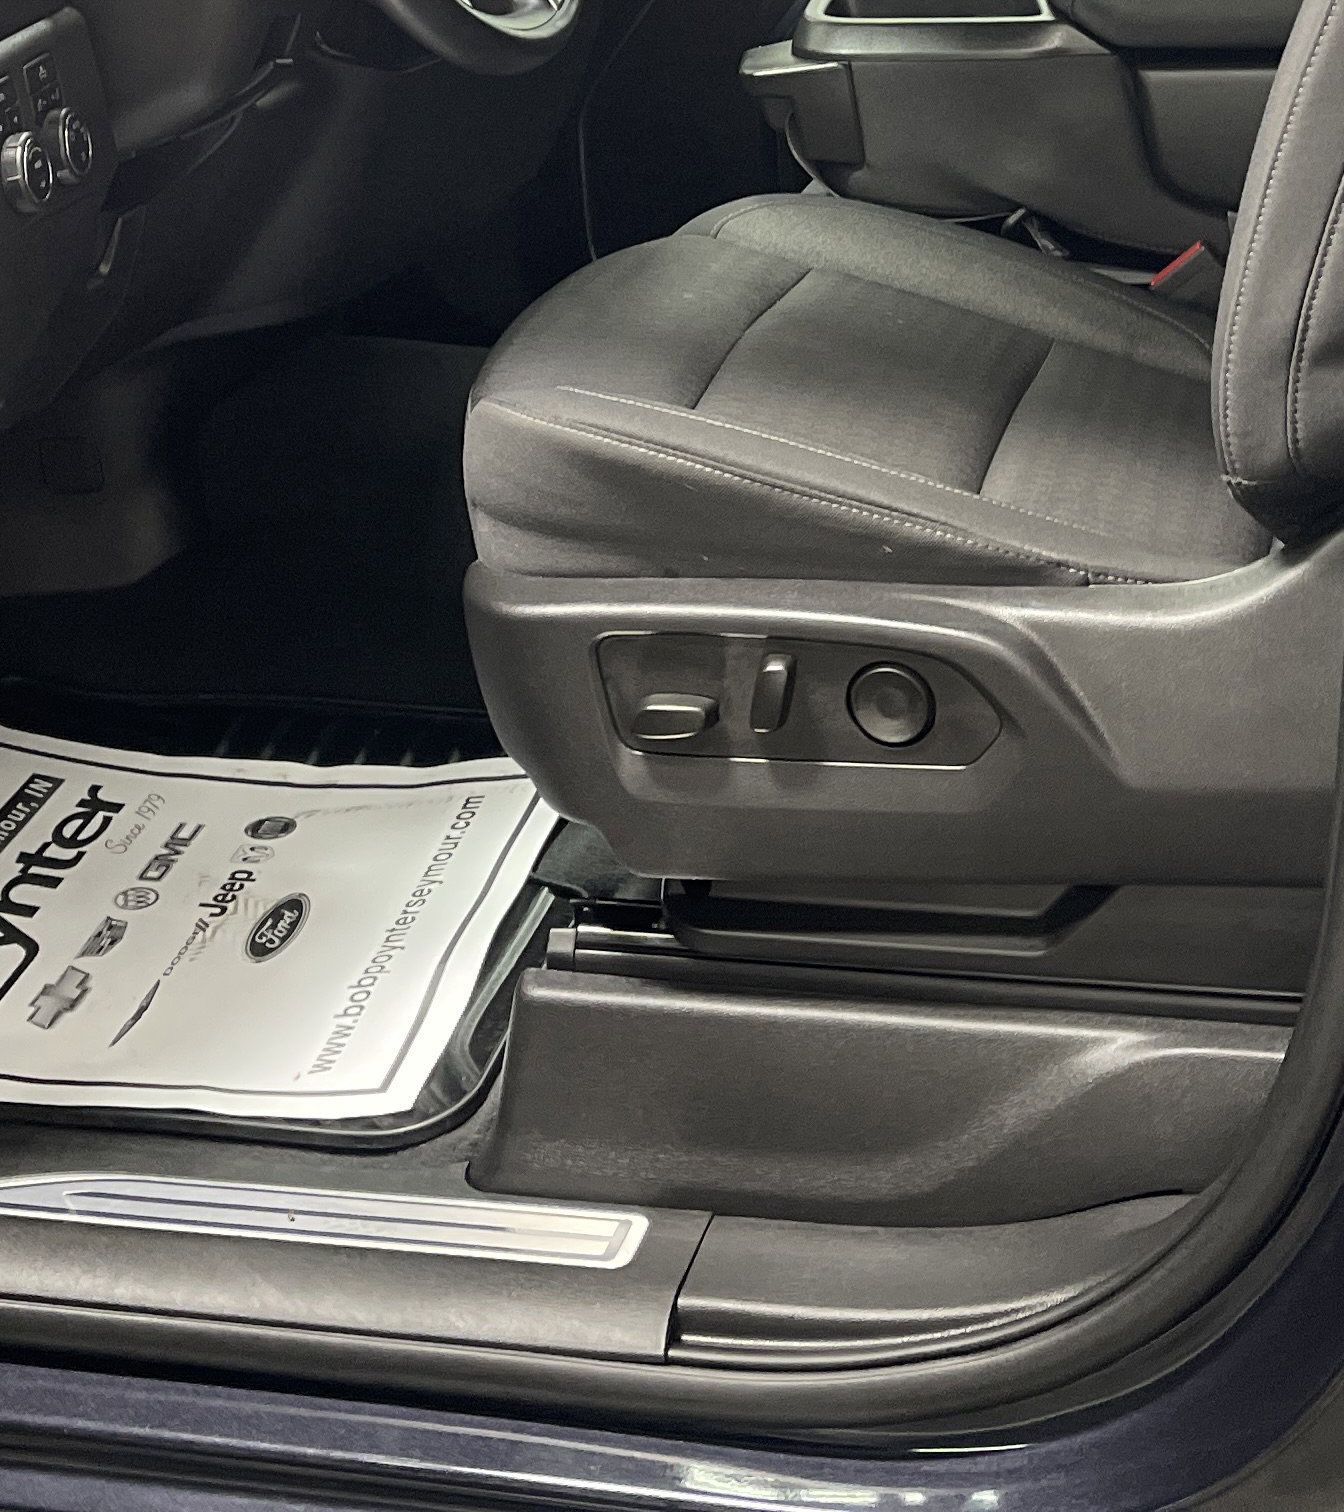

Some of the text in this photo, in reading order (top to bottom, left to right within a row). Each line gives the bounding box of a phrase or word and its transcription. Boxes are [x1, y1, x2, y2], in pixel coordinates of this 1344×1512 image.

[24, 778, 53, 798] IN
[104, 793, 166, 855] Since 1979
[137, 821, 206, 882] GMC
[199, 869, 256, 918] Jeep
[255, 908, 300, 949] Ford
[307, 794, 485, 1075] www.bobpoynterseymour.com
